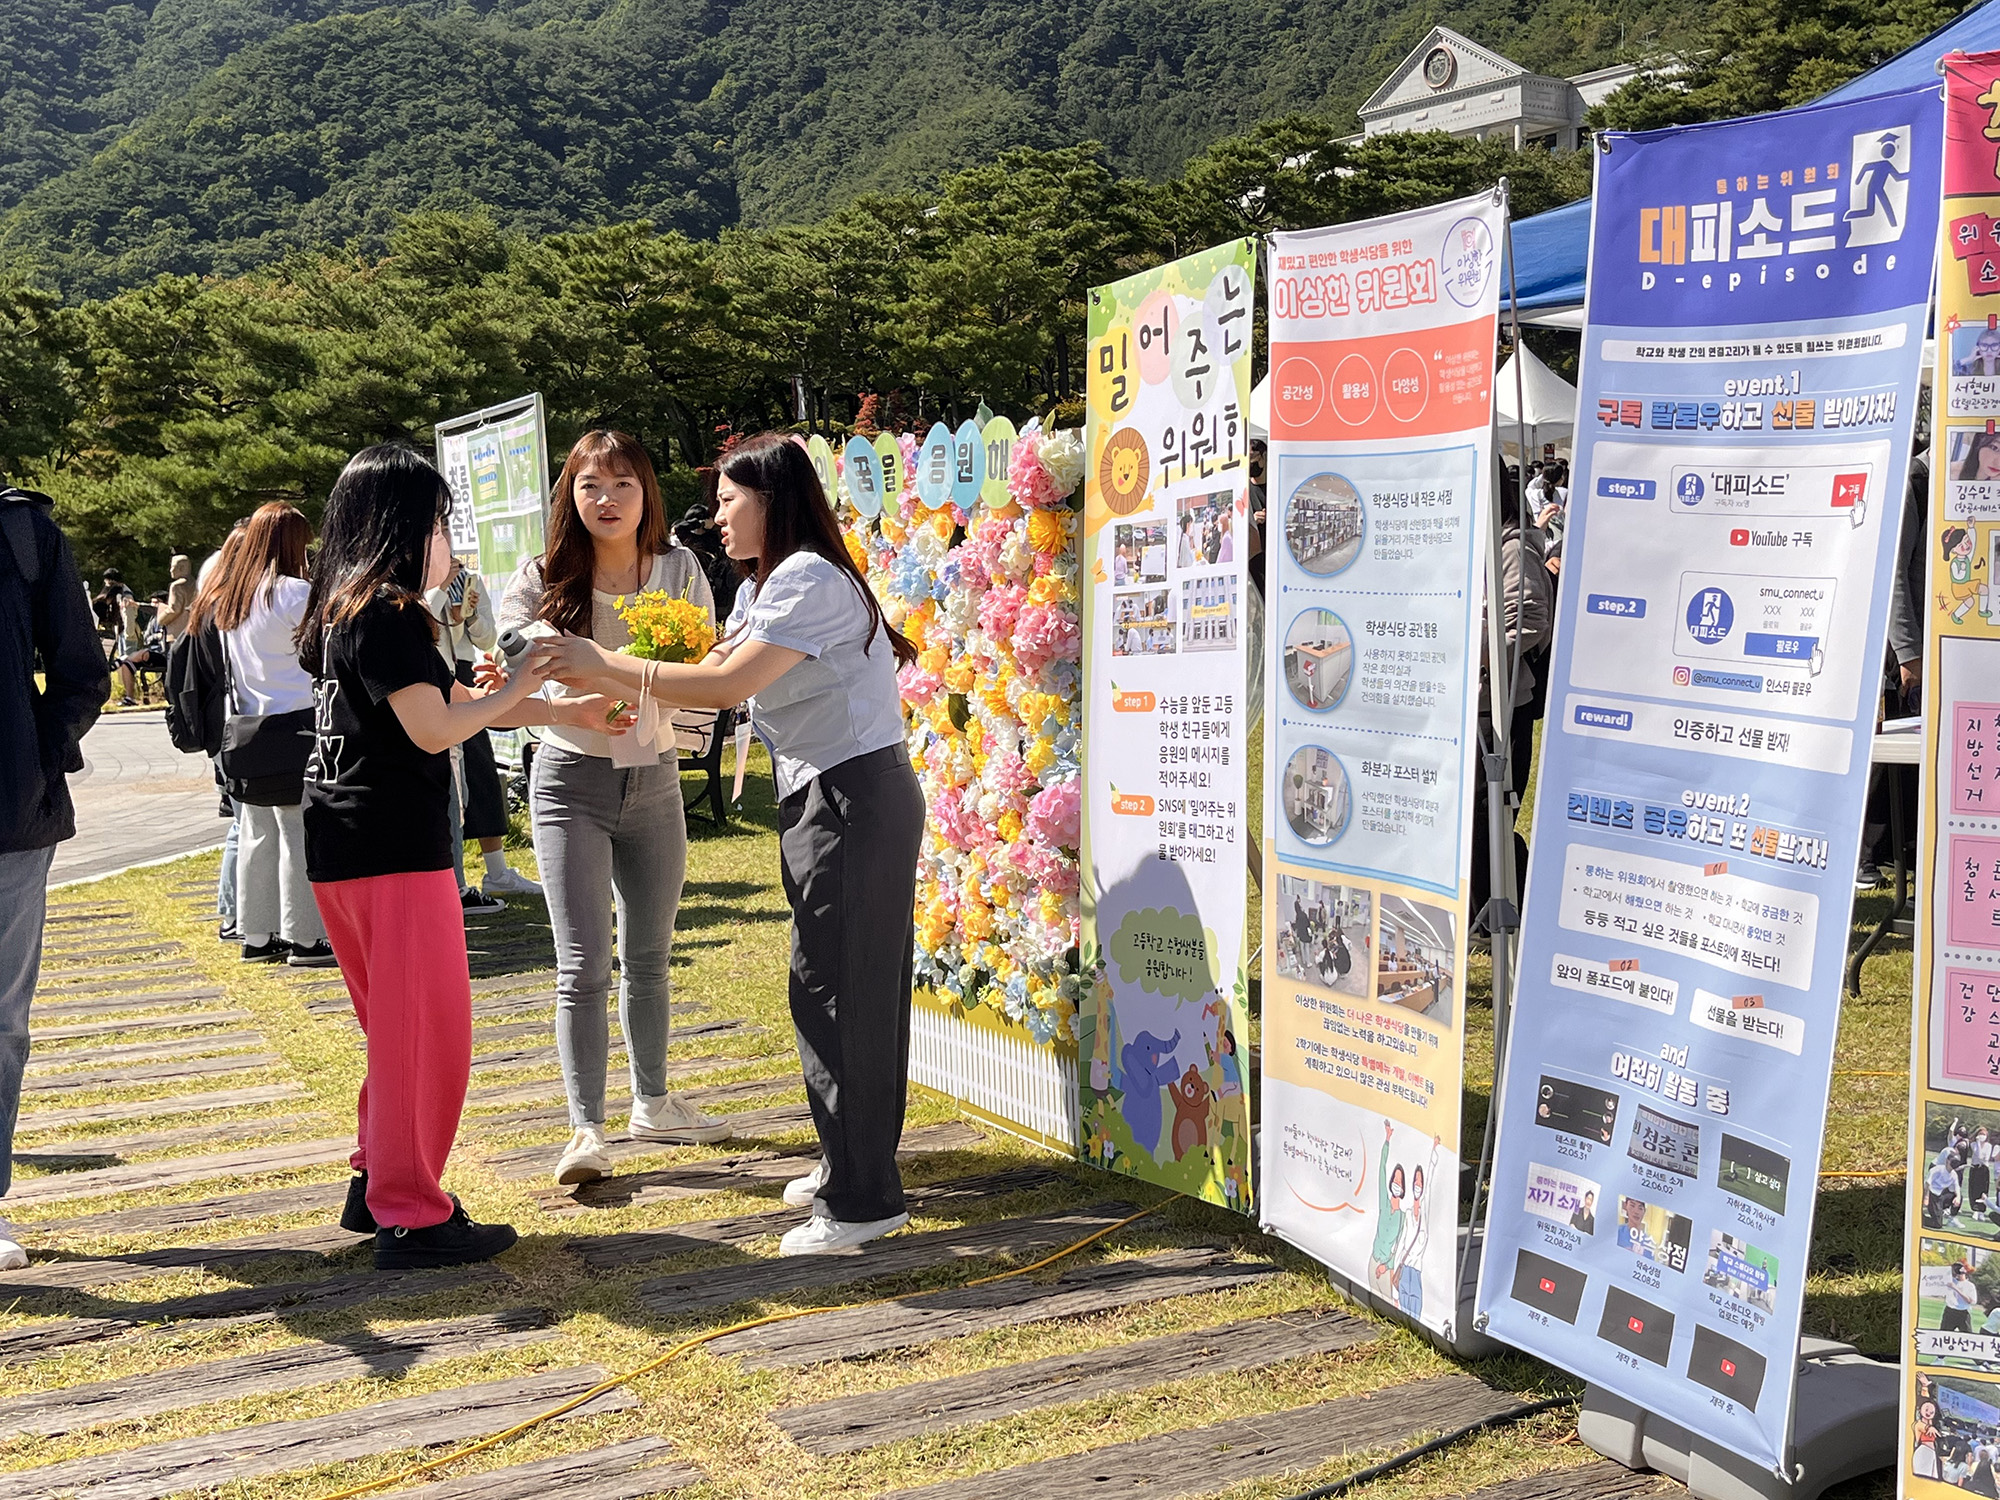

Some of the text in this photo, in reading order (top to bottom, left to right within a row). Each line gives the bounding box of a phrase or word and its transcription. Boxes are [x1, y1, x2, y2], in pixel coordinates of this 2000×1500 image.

[1781, 163, 1839, 186] 위원회
[1639, 189, 1836, 265] 대피소드
[1308, 251, 1337, 269] 편안한
[1339, 244, 1388, 264] 학생식당을
[1392, 239, 1413, 256] 위한
[1642, 254, 1895, 291] D-episode
[1275, 258, 1436, 319] 이상한 위원회
[1636, 347, 1664, 358] 학교와
[1668, 346, 1686, 358] 학생
[1689, 346, 1705, 357] 간의
[1708, 345, 1749, 357] 연결고리가
[1764, 345, 1773, 355] 수
[1776, 342, 1802, 354] 있도록
[1282, 385, 1313, 400] 공간성
[1342, 383, 1369, 399] 활용성
[1393, 377, 1419, 394] 다양성
[1723, 370, 1801, 396] event.1
[1596, 391, 1897, 431] 구독 팔로우하고 선물 받아가자!
[1160, 404, 1248, 488] 위원회
[853, 439, 1008, 493] 꿈을 응원해
[1608, 483, 1645, 496] step.1
[1711, 473, 1790, 495] '대피소드'
[1956, 485, 1991, 500] 김수민
[1373, 490, 1452, 508] 학생식당 내 작은 서점
[1751, 531, 1812, 547] YouTube 구독
[1598, 601, 1636, 614] step.2
[1366, 620, 1407, 637] 학생식당
[1690, 624, 1726, 639] 대피소드
[1364, 649, 1418, 662] 사용하지 못하고
[1776, 640, 1800, 653] 팔로우
[1363, 662, 1411, 677] 작은 회의실과
[1362, 677, 1417, 692] 학생들의 의견을
[1766, 679, 1789, 695] 인스타
[1792, 682, 1811, 697] 팔로우
[1124, 696, 1148, 708] step 1
[1160, 696, 1233, 714] 수능을 앞둔 고등
[1159, 721, 1230, 739] 학생 친구들에게
[1581, 711, 1628, 727] reward!
[1673, 719, 1789, 752] 인증하고 선물 받자!
[1159, 746, 1230, 765] 응원의 메시지를
[1965, 719, 1984, 801] 지방선거
[1159, 771, 1211, 789] 적어주세요!
[1361, 761, 1437, 785] 화분과 포스터 설치
[1121, 800, 1145, 812] step 2
[1158, 799, 1235, 818] SNS에 '밀어주는 위
[1158, 821, 1234, 843] 원회'를 태그하고 선
[1567, 792, 1829, 869] 컨텐츠 공유하고 또 선물받자!
[1159, 844, 1216, 862] 물 받아가세요!
[1585, 866, 1614, 880] 통하는
[1618, 870, 1664, 890] 위원회에서
[1964, 858, 1980, 902] 청춘
[1583, 886, 1622, 904] 학교에서
[1665, 902, 1682, 917] 하는
[1684, 907, 1693, 920] 것
[1761, 904, 1803, 926] 궁금한 것
[1584, 910, 1780, 972] 등등 적고 싶은 것들을 포스트잇에 적는다!
[1747, 925, 1772, 943] 좋았던
[1776, 931, 1786, 946] 것
[1557, 964, 1581, 982] 앞의
[1638, 982, 1672, 1004] 붙인다!
[1959, 983, 1976, 1023] 건강
[1295, 994, 1411, 1036] 이상한 위원회는 더 나은 학생식당을
[1707, 1006, 1783, 1039] 선물을 받는다!
[1352, 1026, 1374, 1043] 노력을
[1295, 1038, 1329, 1056] 2학기에는
[1331, 1047, 1360, 1066] 학생식당
[1660, 1042, 1689, 1069] and
[1305, 1057, 1390, 1092] 계획하고 있으니 많은 관심
[1611, 1051, 1729, 1116] 여전히 활동 중
[1641, 1125, 1676, 1160] 청춘
[1527, 1186, 1580, 1215] 자기 소개
[1932, 1336, 1983, 1352] 지방선거
